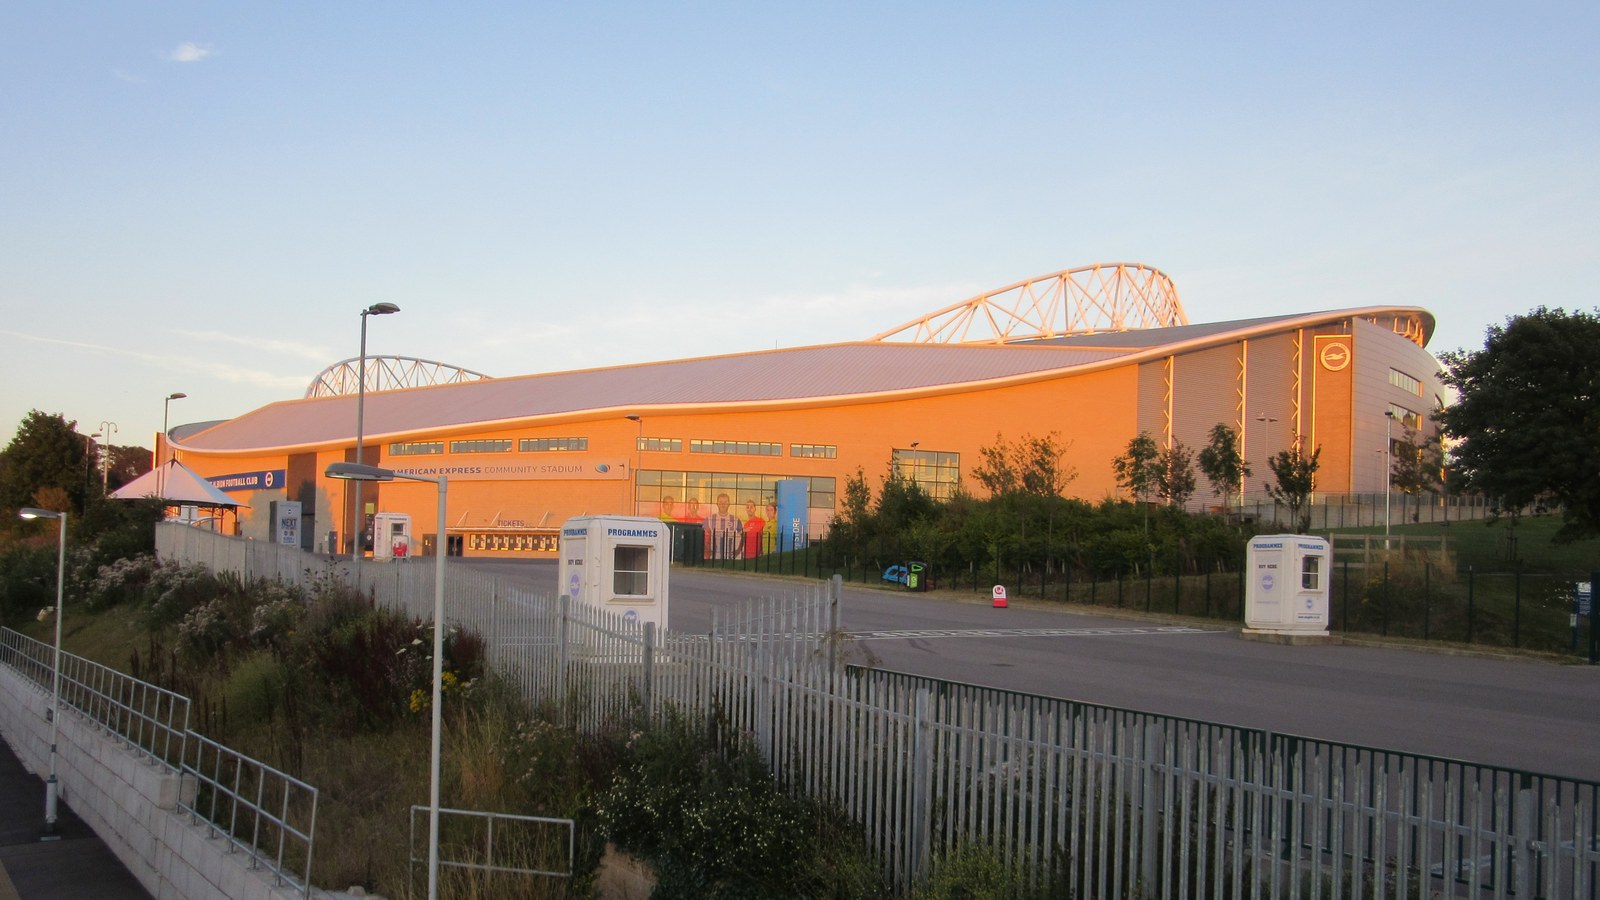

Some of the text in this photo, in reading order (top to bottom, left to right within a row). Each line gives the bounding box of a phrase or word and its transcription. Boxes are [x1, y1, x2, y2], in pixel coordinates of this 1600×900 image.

[439, 467, 481, 475] EXPRESS
[484, 465, 537, 474] COMMUNITY
[540, 465, 583, 473] STADIUM
[226, 478, 246, 487] FOOTBALL
[246, 476, 258, 485] CLUB
[281, 518, 297, 526] NEXT
[497, 519, 525, 527] TICKETS
[564, 528, 588, 536] PROGRAMMES
[608, 528, 658, 537] PROGRAMMES
